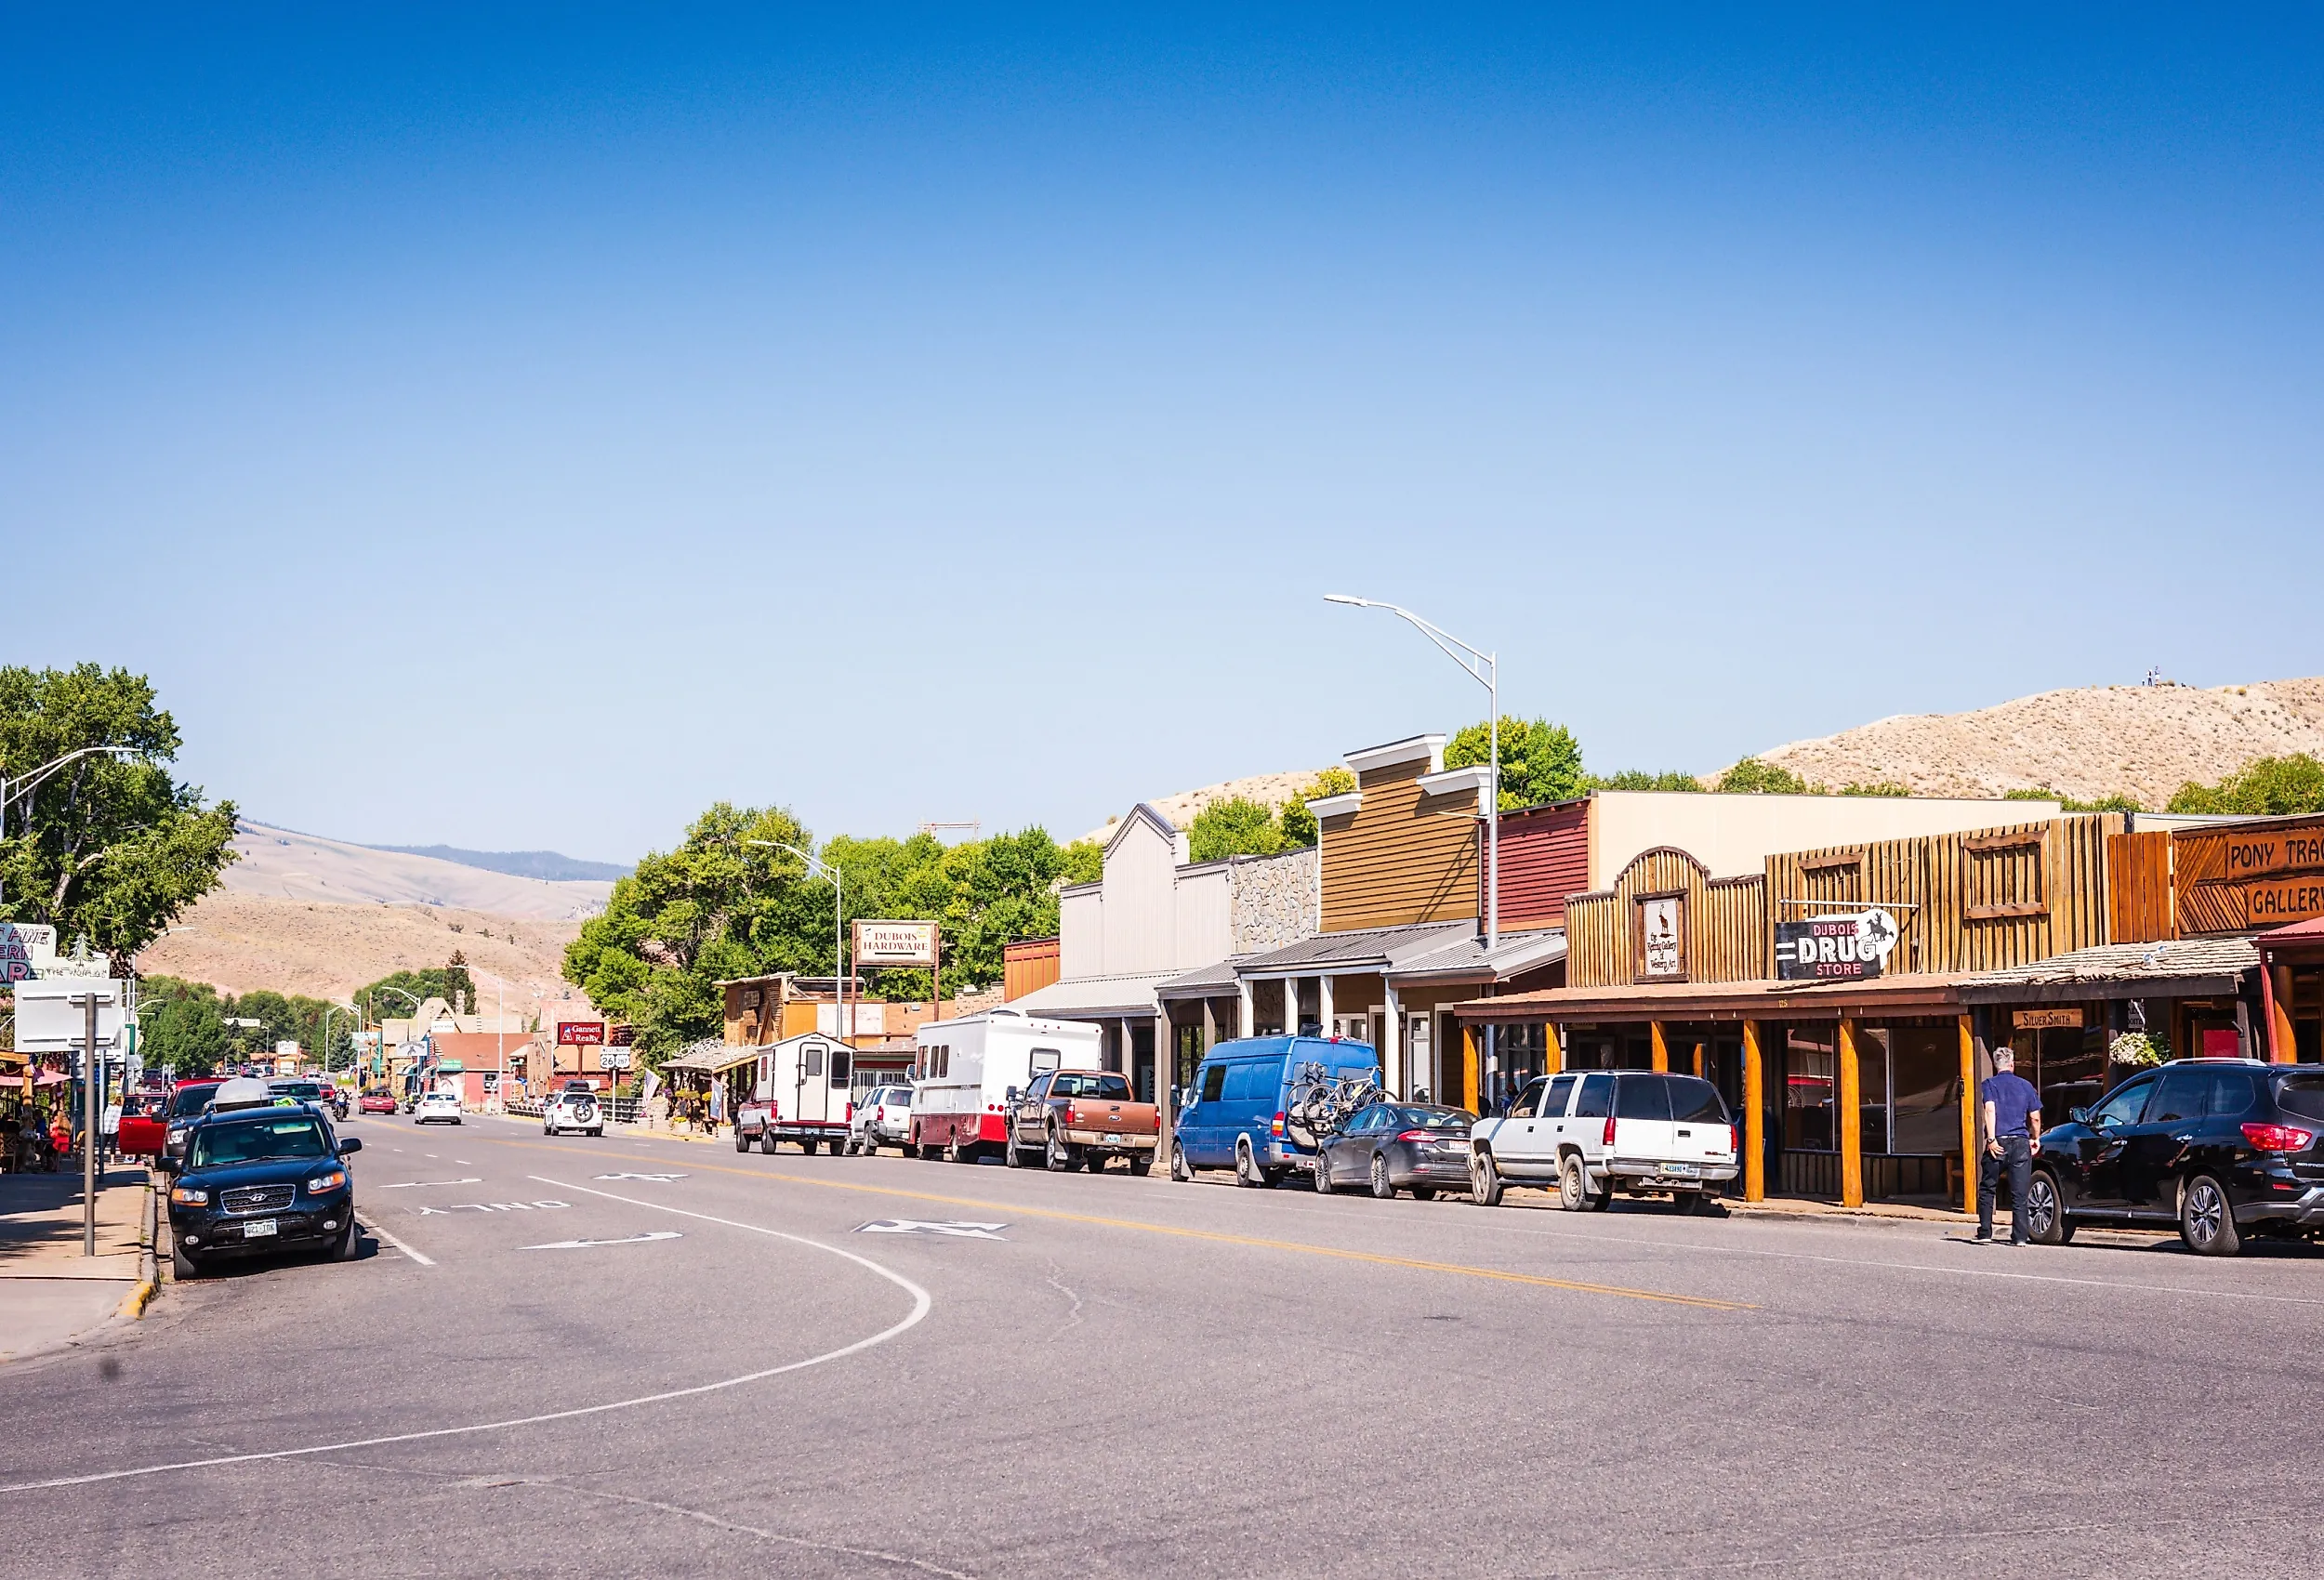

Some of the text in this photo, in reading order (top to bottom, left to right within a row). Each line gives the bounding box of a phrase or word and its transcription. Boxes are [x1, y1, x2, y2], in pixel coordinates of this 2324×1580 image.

[2231, 843, 2275, 869] PONY
[7, 928, 50, 945] PINE
[875, 932, 918, 941] DUBOIS
[1813, 923, 1859, 937] DUBOIS
[864, 941, 928, 951] HARDWARE
[1798, 934, 1877, 964] DRUG
[1816, 963, 1862, 976] STORE
[572, 1024, 601, 1033] Gannett
[575, 1034, 601, 1044] Realty
[601, 1057, 614, 1066] 26
[419, 1200, 572, 1217] ONLY
